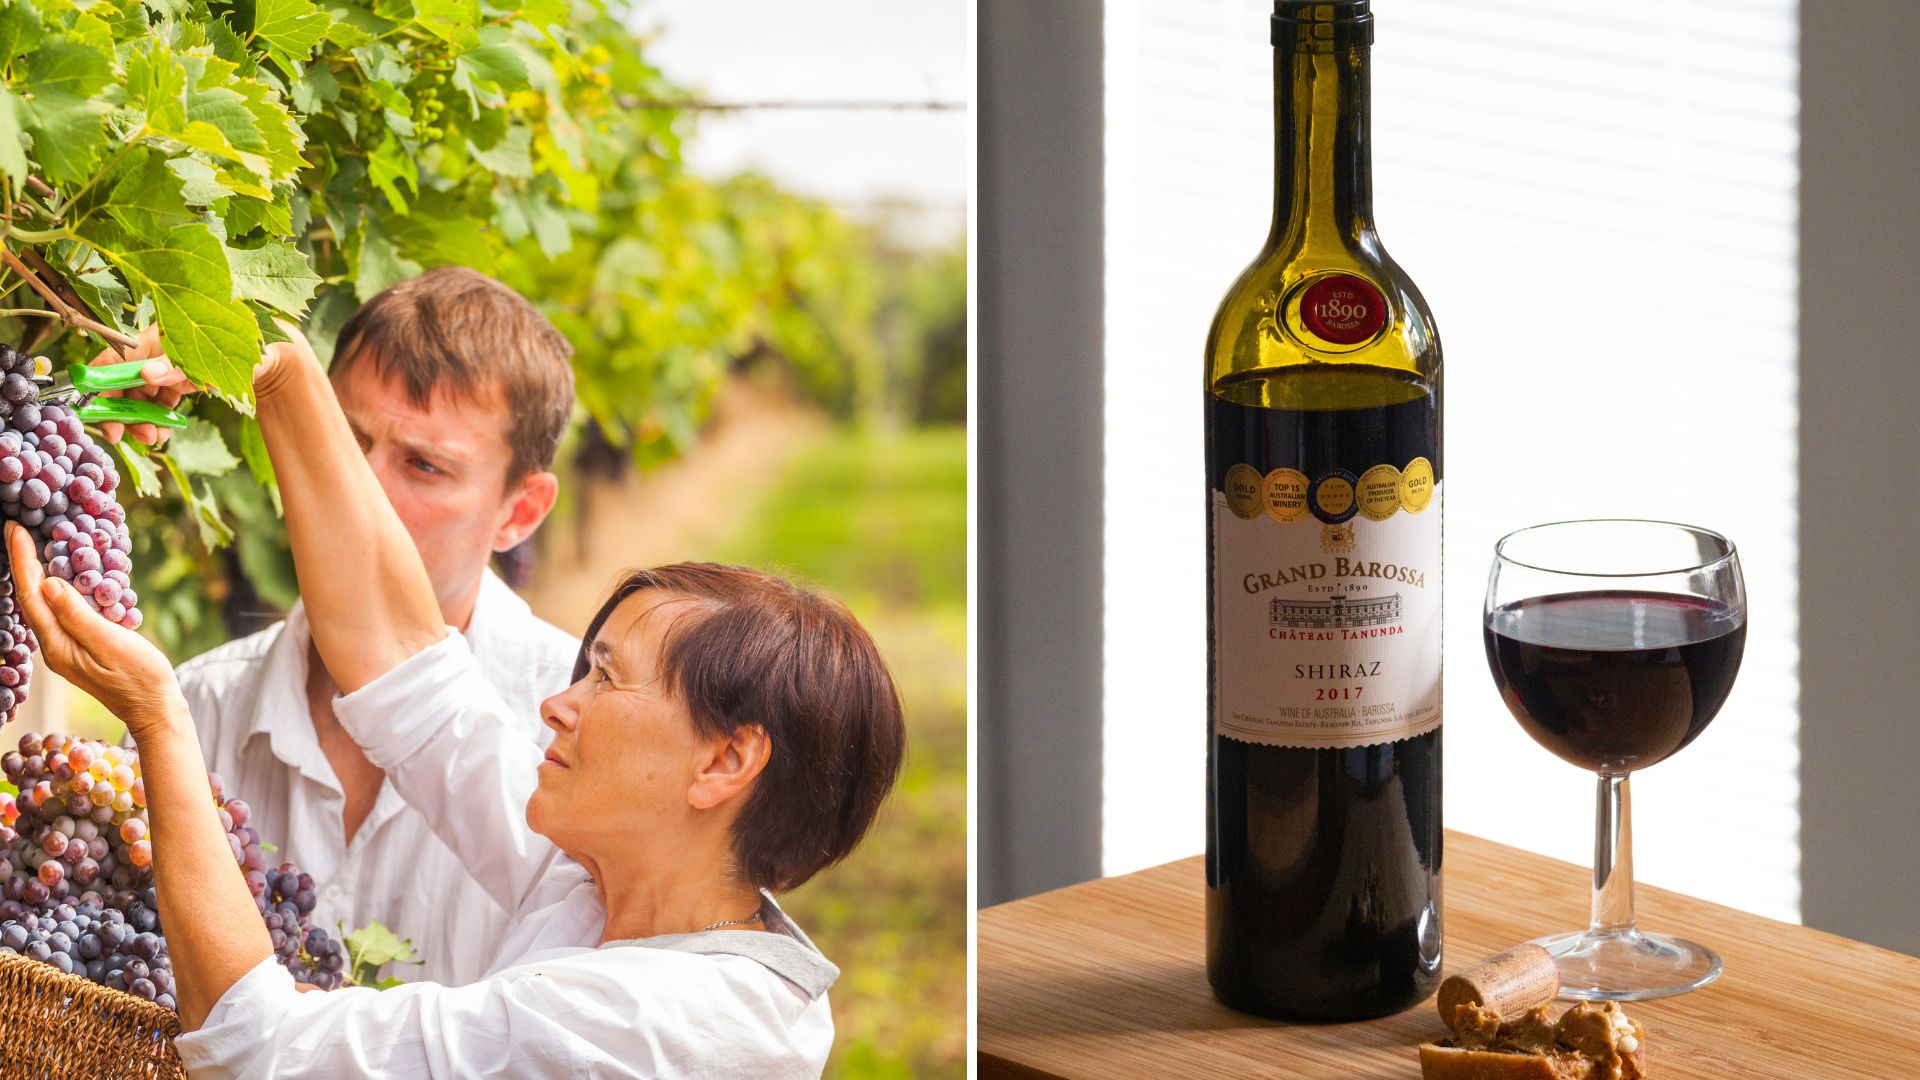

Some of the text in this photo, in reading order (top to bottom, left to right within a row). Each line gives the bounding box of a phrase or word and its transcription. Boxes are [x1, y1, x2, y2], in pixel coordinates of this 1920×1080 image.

[1332, 291, 1354, 299] ESTD
[1320, 299, 1367, 322] 1890
[1326, 319, 1361, 330] BAROSSA
[1274, 483, 1300, 492] TOP 15
[1365, 481, 1396, 490] AUSTRALIAN
[1408, 476, 1427, 488] GOLD
[1233, 483, 1256, 494] GOLD
[1368, 488, 1394, 496] PRODUCER
[1269, 492, 1306, 500] AUSTRALIAN
[1272, 500, 1302, 509] WINERY
[1243, 557, 1425, 595] GRAND BAROSSA
[1344, 584, 1369, 592] 1890
[1269, 625, 1404, 641] CHÂTEAU TANUNDA
[1295, 661, 1382, 679] SHIRAZ
[1316, 687, 1363, 701] 2017
[1280, 707, 1300, 719] WINE
[1302, 709, 1311, 719] OF
[1313, 707, 1356, 719] AUSTRALIA
[1362, 702, 1396, 717] BAROSSA
